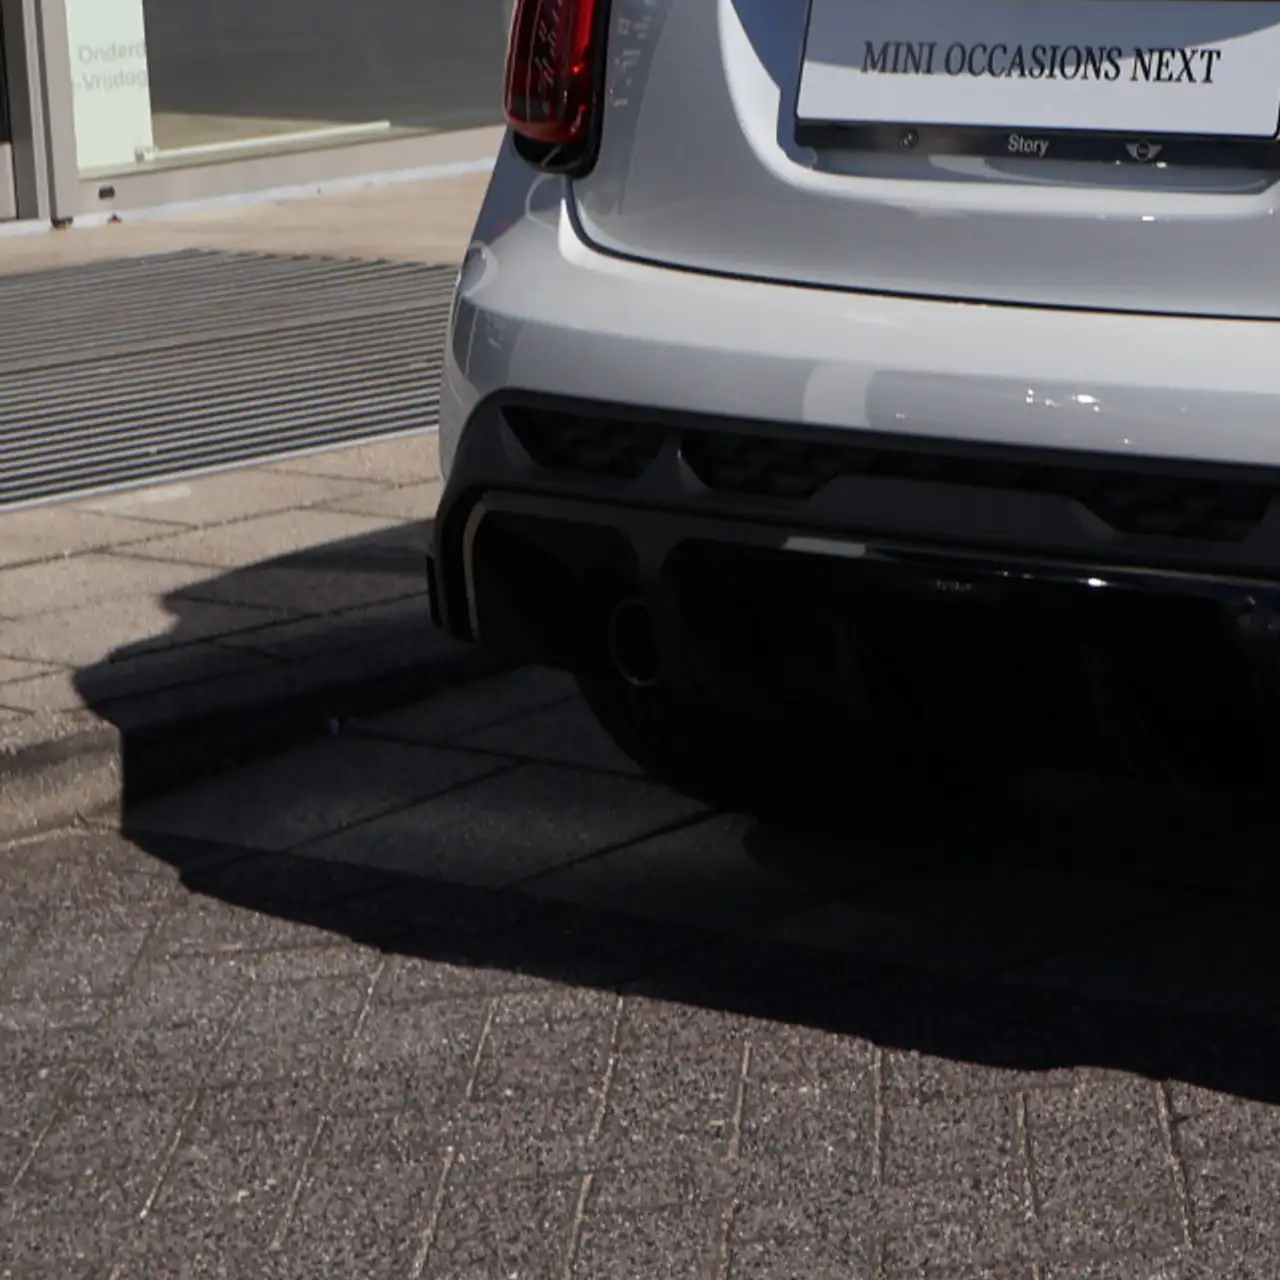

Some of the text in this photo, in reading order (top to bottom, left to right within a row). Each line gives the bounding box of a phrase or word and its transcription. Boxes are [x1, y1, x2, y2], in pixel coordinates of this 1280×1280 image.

[861, 39, 1222, 84] MINI OCCASIONS NEXT
[1007, 133, 1050, 156] Story
